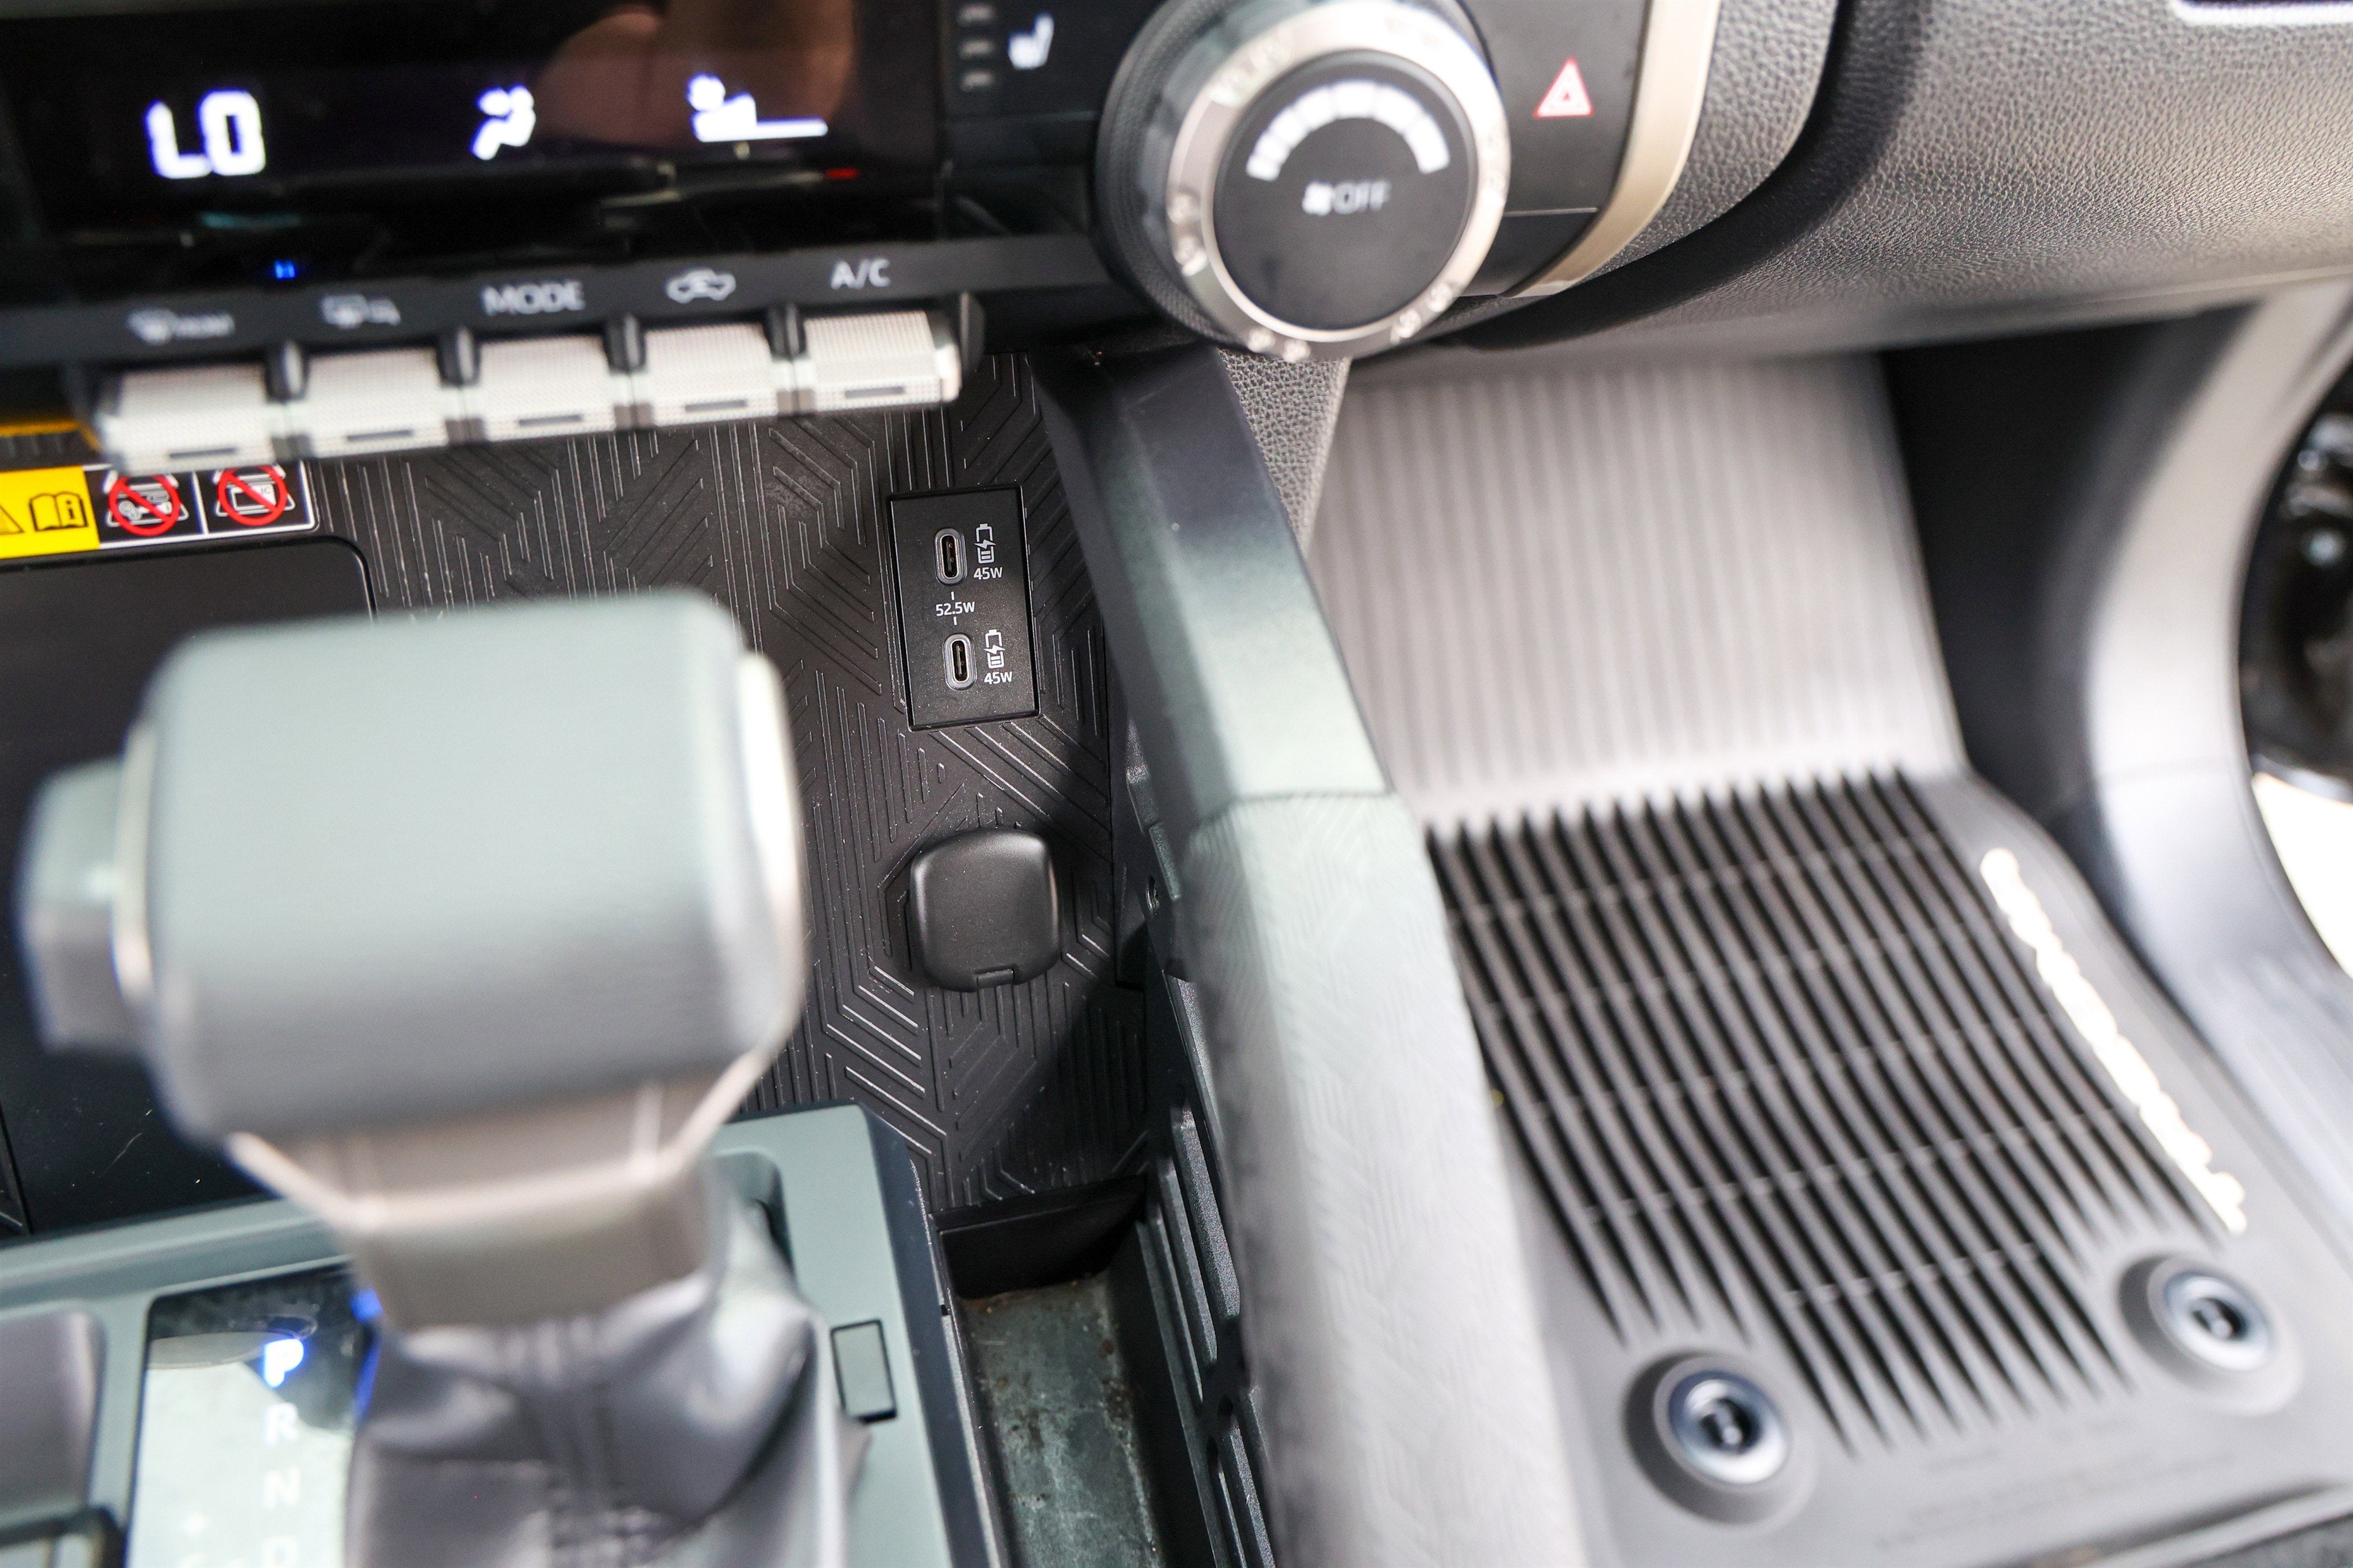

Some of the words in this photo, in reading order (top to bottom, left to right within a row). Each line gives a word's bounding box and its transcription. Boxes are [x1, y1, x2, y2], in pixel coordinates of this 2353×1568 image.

[1332, 179, 1390, 215] OFF
[831, 258, 890, 289] A/C
[481, 280, 585, 316] MODE
[974, 566, 1003, 580] 45W
[935, 601, 975, 616] 52.5W
[983, 671, 1013, 685] 45W
[262, 1337, 305, 1389] P
[263, 1402, 299, 1445] R
